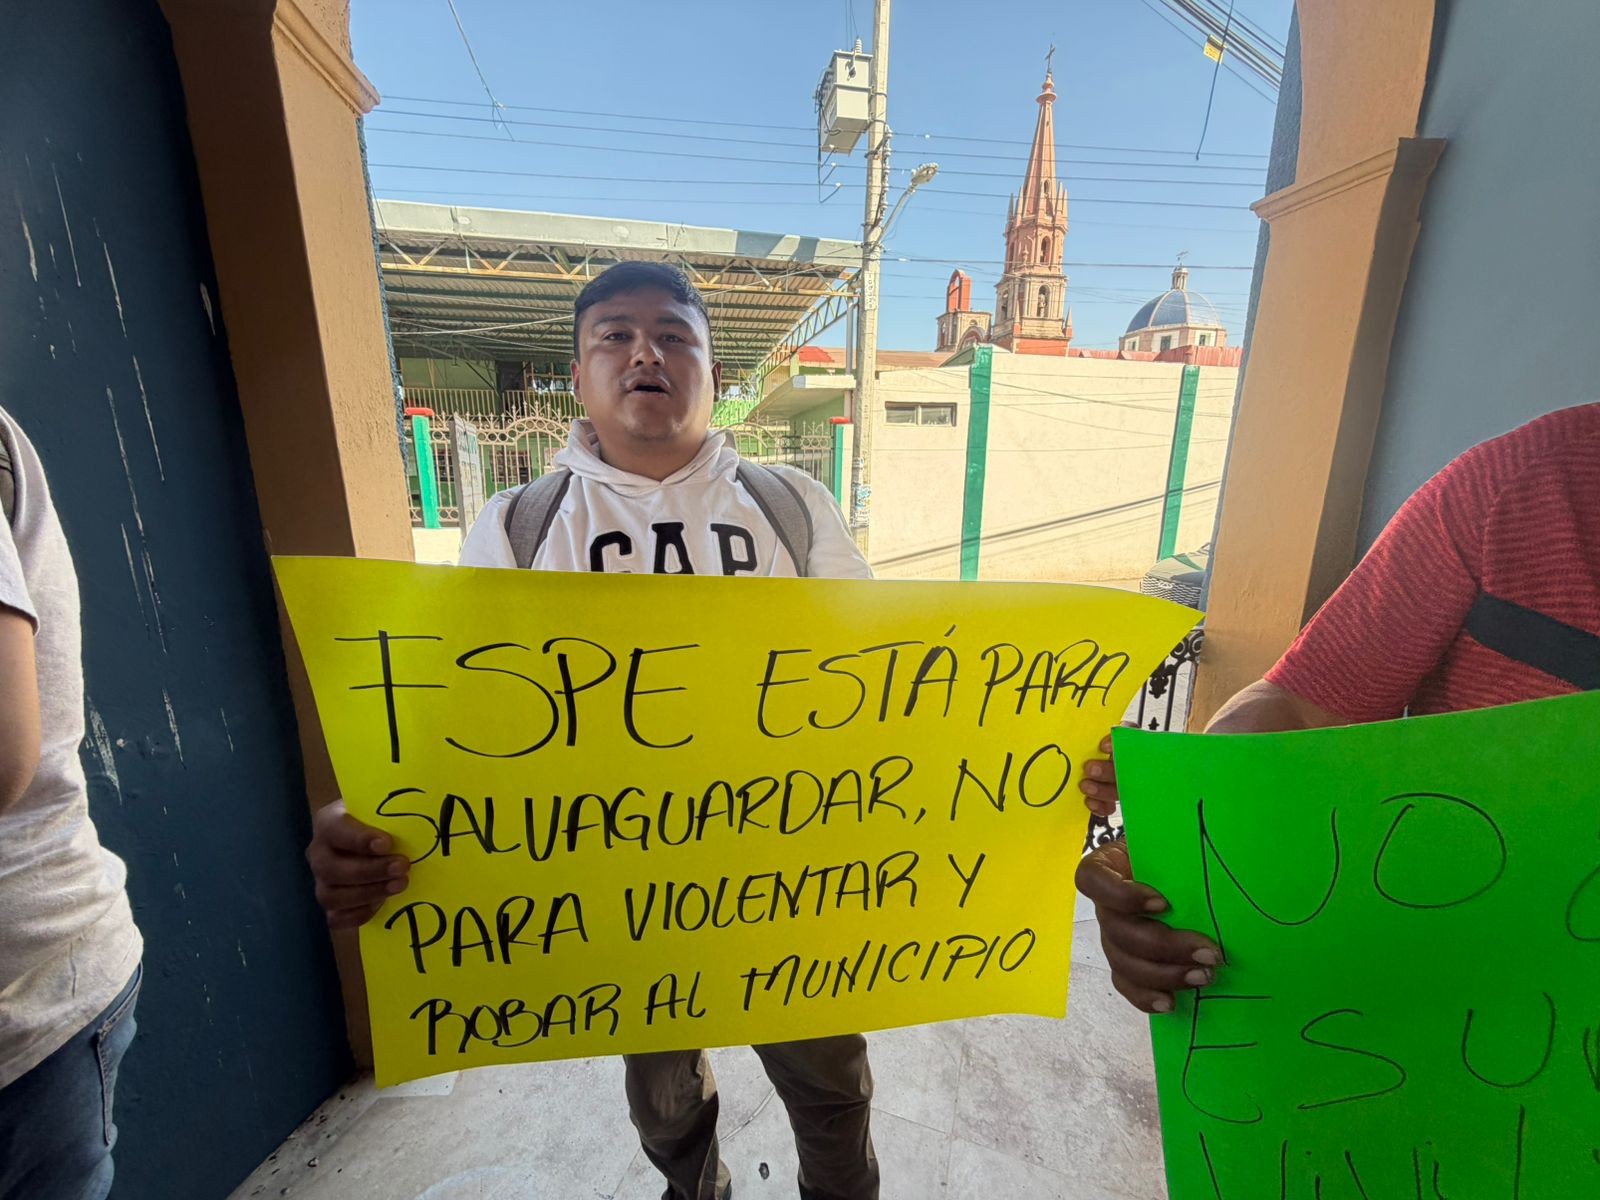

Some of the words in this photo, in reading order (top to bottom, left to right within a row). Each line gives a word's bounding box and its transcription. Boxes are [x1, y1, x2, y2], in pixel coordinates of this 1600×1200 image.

[334, 629, 700, 763] FSPE
[756, 625, 959, 739] ESTÁ
[978, 639, 1131, 728] PARA
[376, 755, 926, 865] SALVAGUARDAR,
[949, 743, 1073, 822] NO
[384, 893, 589, 975] PARA
[624, 850, 919, 942] VIOLENTAR
[947, 852, 987, 909] Y
[1196, 792, 1508, 966] NO
[409, 983, 622, 1056] ROBAR
[645, 972, 707, 1026] AL
[739, 927, 1037, 1013] MUNICIPIO
